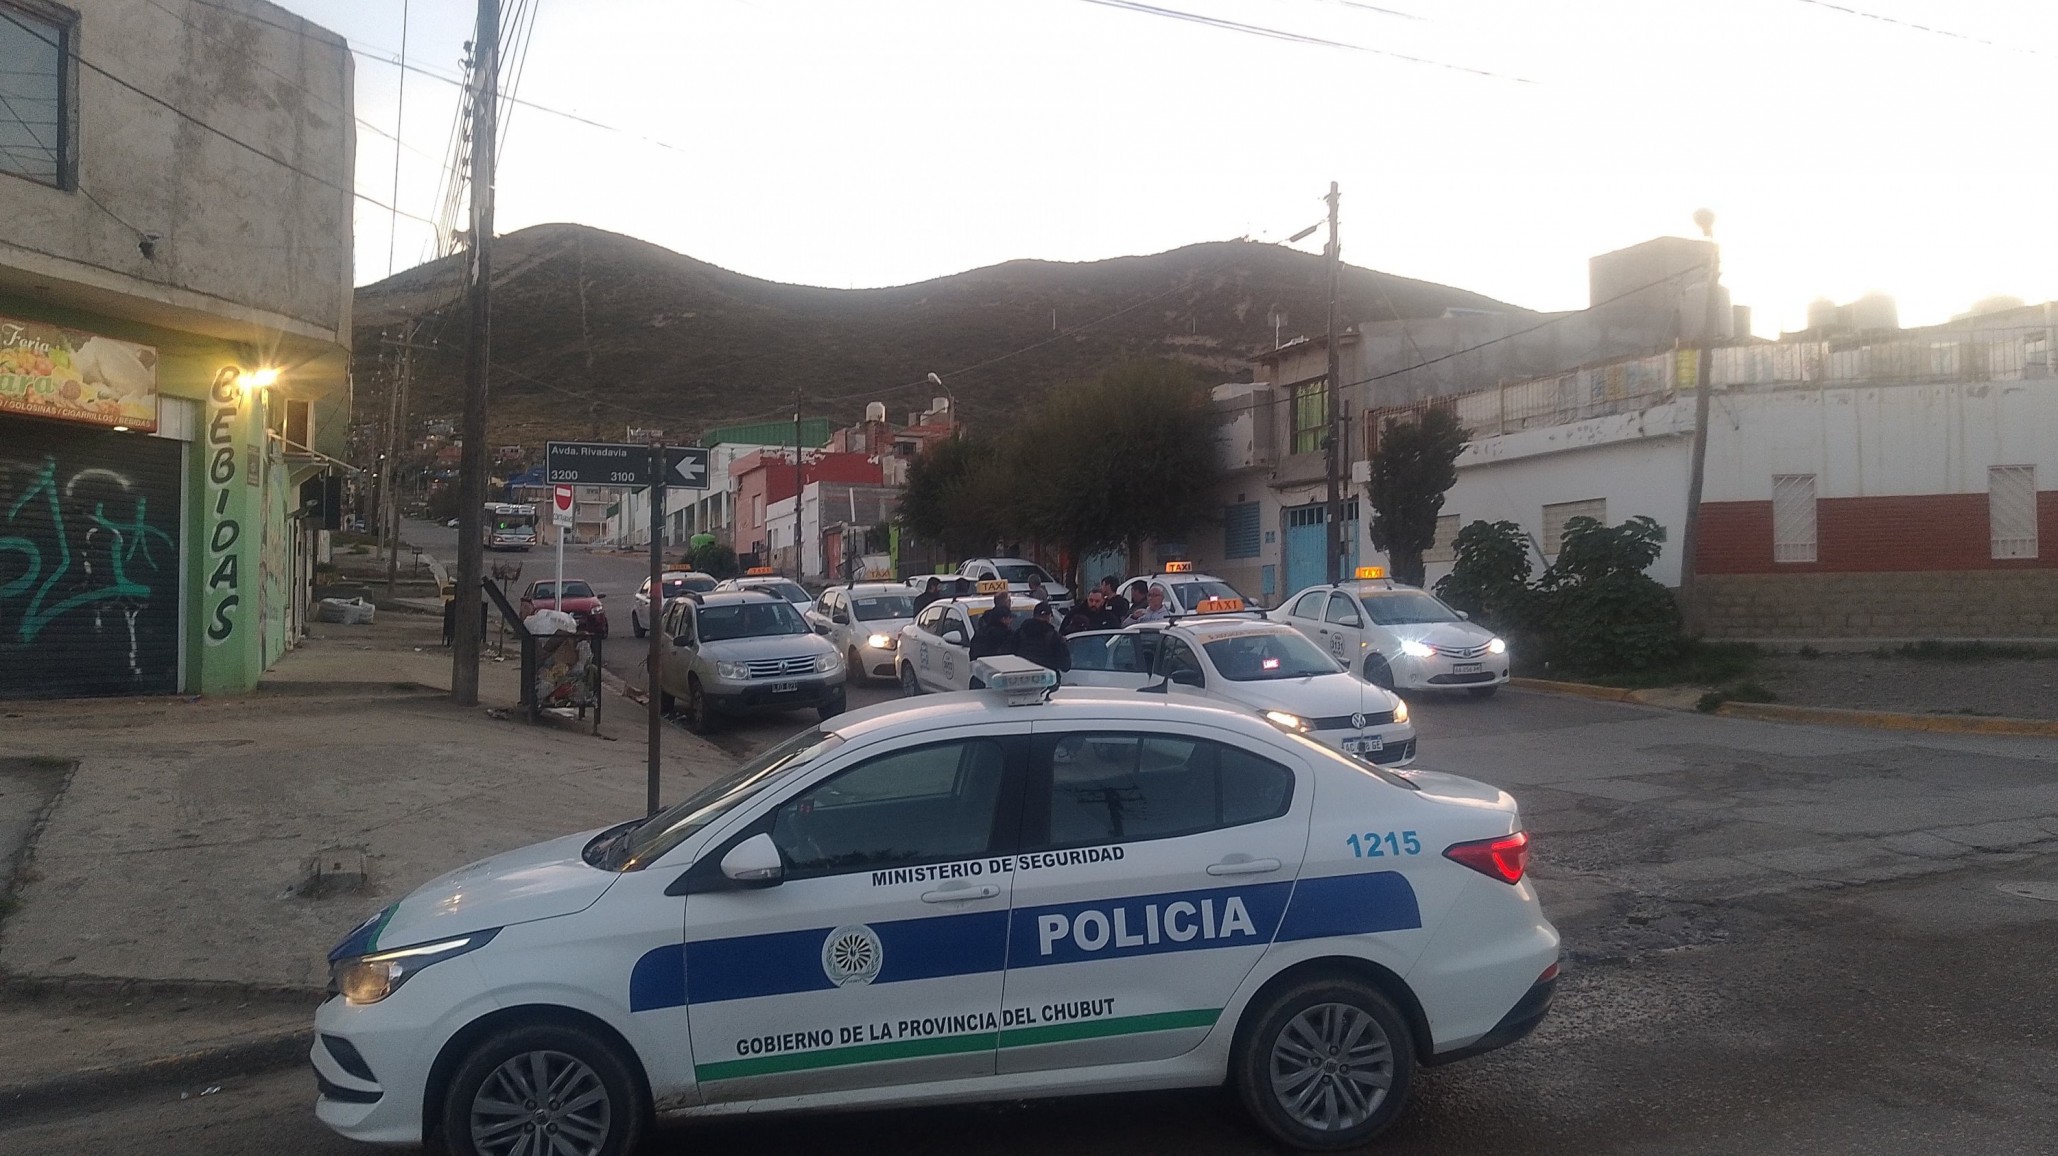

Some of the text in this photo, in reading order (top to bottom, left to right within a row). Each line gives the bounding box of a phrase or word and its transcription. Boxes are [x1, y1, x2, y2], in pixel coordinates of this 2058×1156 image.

[1, 322, 50, 351] Feria
[9, 402, 57, 415] GOLOSINAS
[62, 408, 114, 423] CIGARRILLOS
[118, 416, 151, 428] BEBIDAS
[551, 446, 627, 457] Avda. Rivadavia
[551, 470, 635, 482] 3200 3100
[206, 365, 242, 640] BEBIDAS
[870, 570, 891, 578] TAXI
[1169, 563, 1191, 572] TAXI
[1361, 568, 1383, 577] TAXI
[982, 582, 1006, 591] TAXI
[1206, 600, 1237, 611] TAXI
[1346, 830, 1421, 859] 1215
[872, 846, 1125, 887] MINISTERIO DE SEGURIDAD
[1038, 896, 1256, 956] POLICIA
[736, 997, 1115, 1056] GOBIERNO DE LA PROVINCIA DEL CHUBUT
